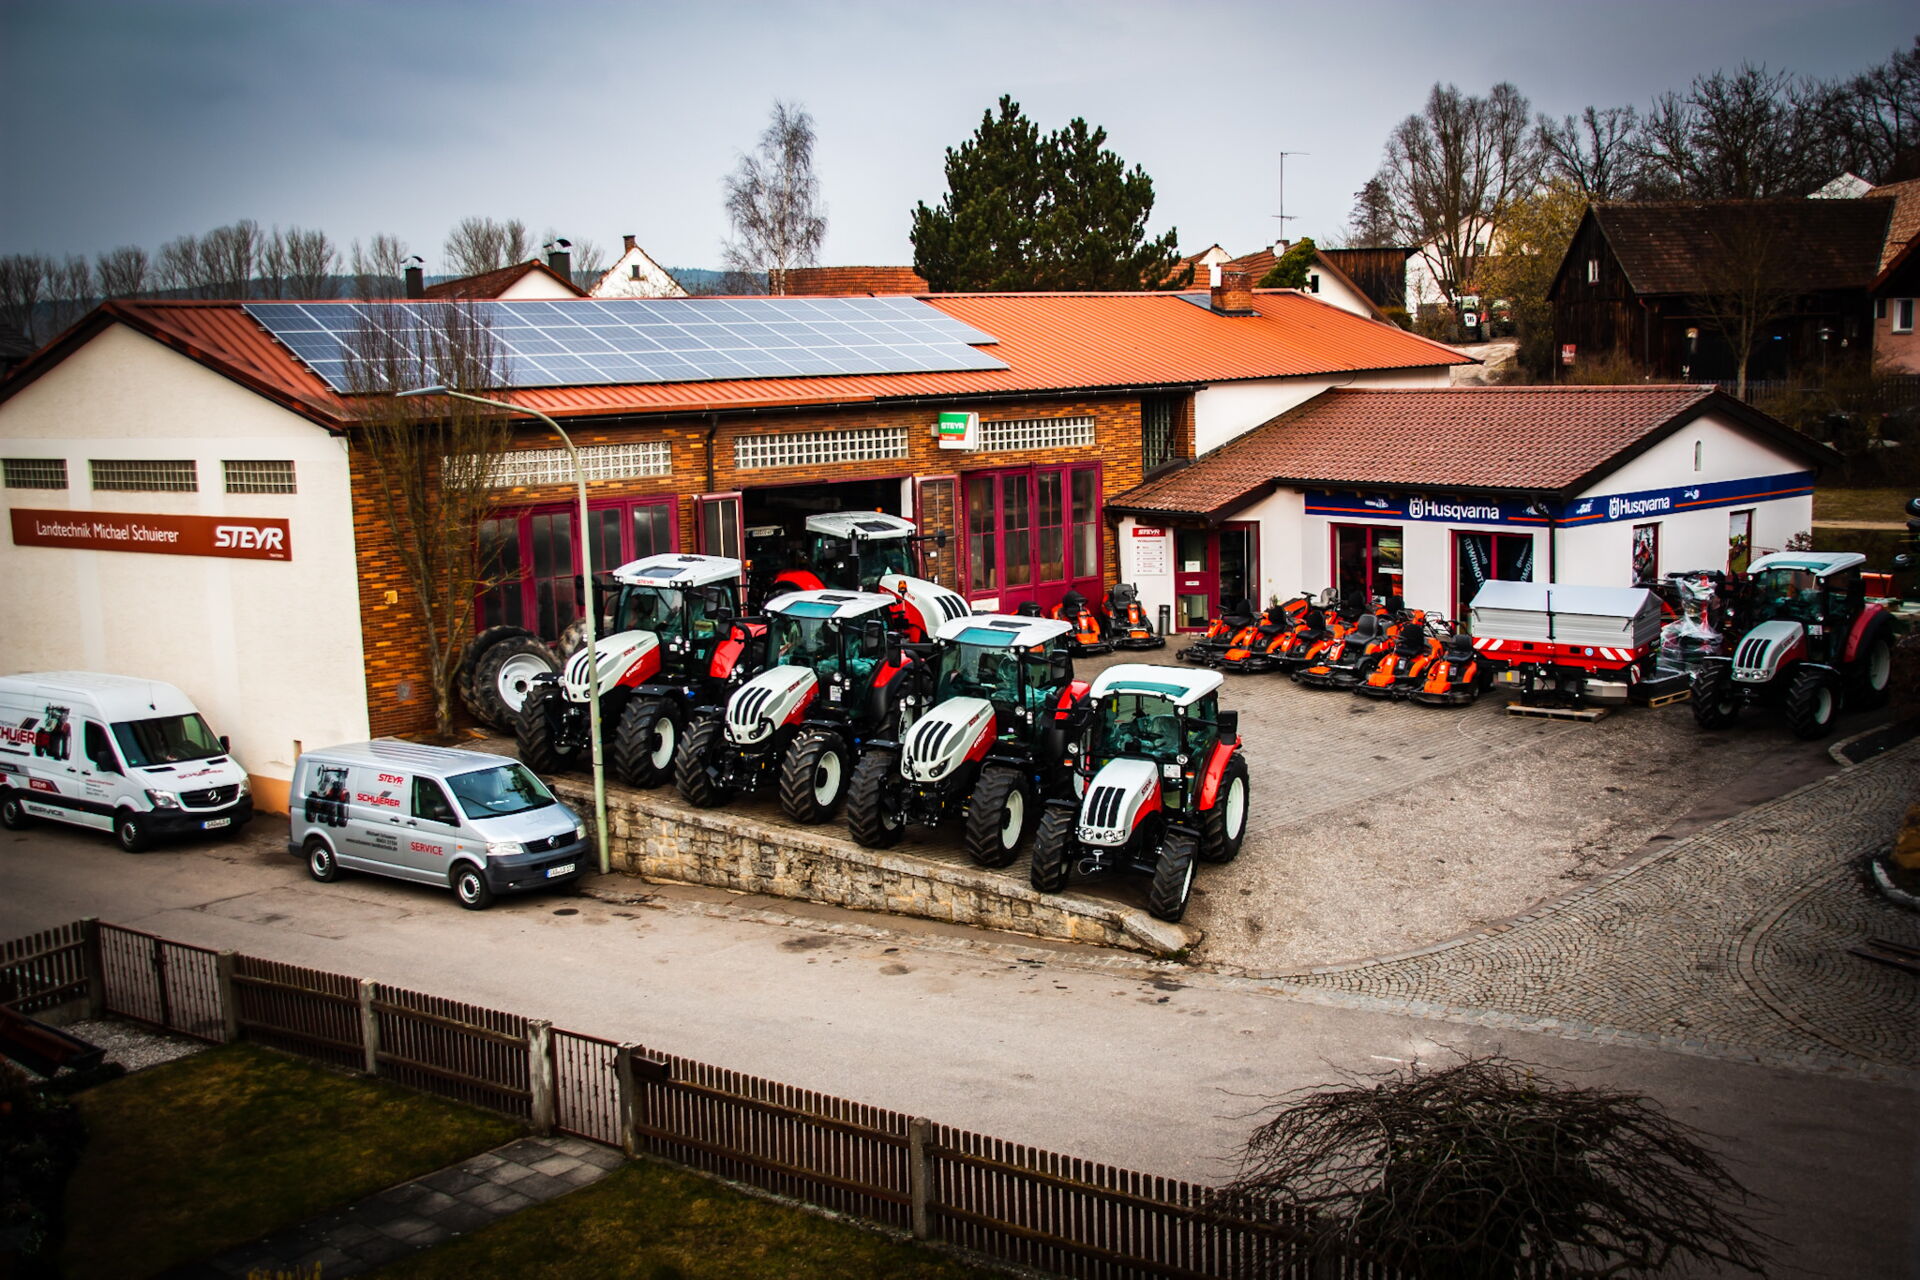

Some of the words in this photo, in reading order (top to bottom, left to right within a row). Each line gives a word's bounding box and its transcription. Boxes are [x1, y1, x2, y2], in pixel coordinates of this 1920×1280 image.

[1425, 499, 1500, 520] Husqvarna
[1619, 495, 1670, 515] Husqvarna
[36, 520, 91, 538] Landtechnik
[93, 522, 130, 541] Michael
[132, 523, 179, 544] Schuierer
[214, 525, 284, 550] STEYR
[1138, 528, 1161, 536] STEYR
[378, 773, 404, 785] STEYR
[357, 793, 401, 808] SCHUIERER
[410, 841, 443, 856] SERVICE
